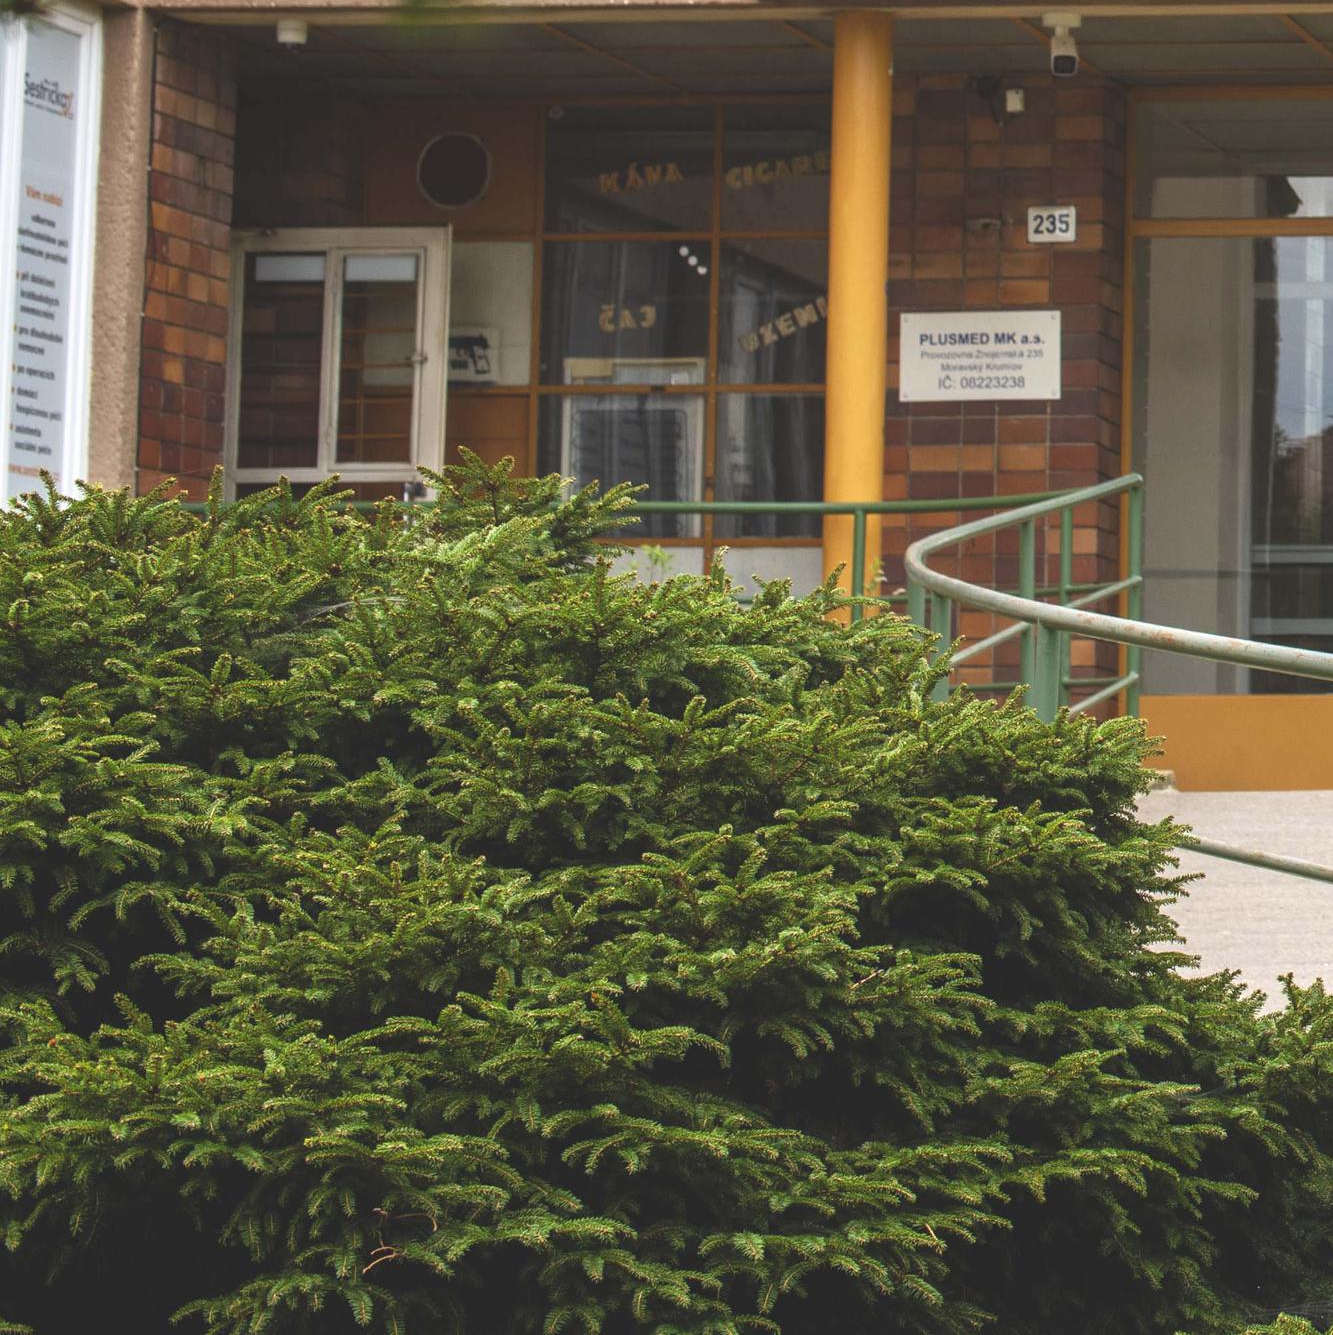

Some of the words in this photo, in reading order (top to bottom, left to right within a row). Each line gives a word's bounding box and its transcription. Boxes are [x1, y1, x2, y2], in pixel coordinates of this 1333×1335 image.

[1033, 214, 1070, 234] 235
[599, 304, 657, 332] ČAJ
[919, 332, 990, 346] PLUSMED
[994, 332, 1016, 345] MK
[1020, 334, 1045, 345] a.s.
[1026, 349, 1044, 358] 235
[960, 376, 1026, 389] 08223238
